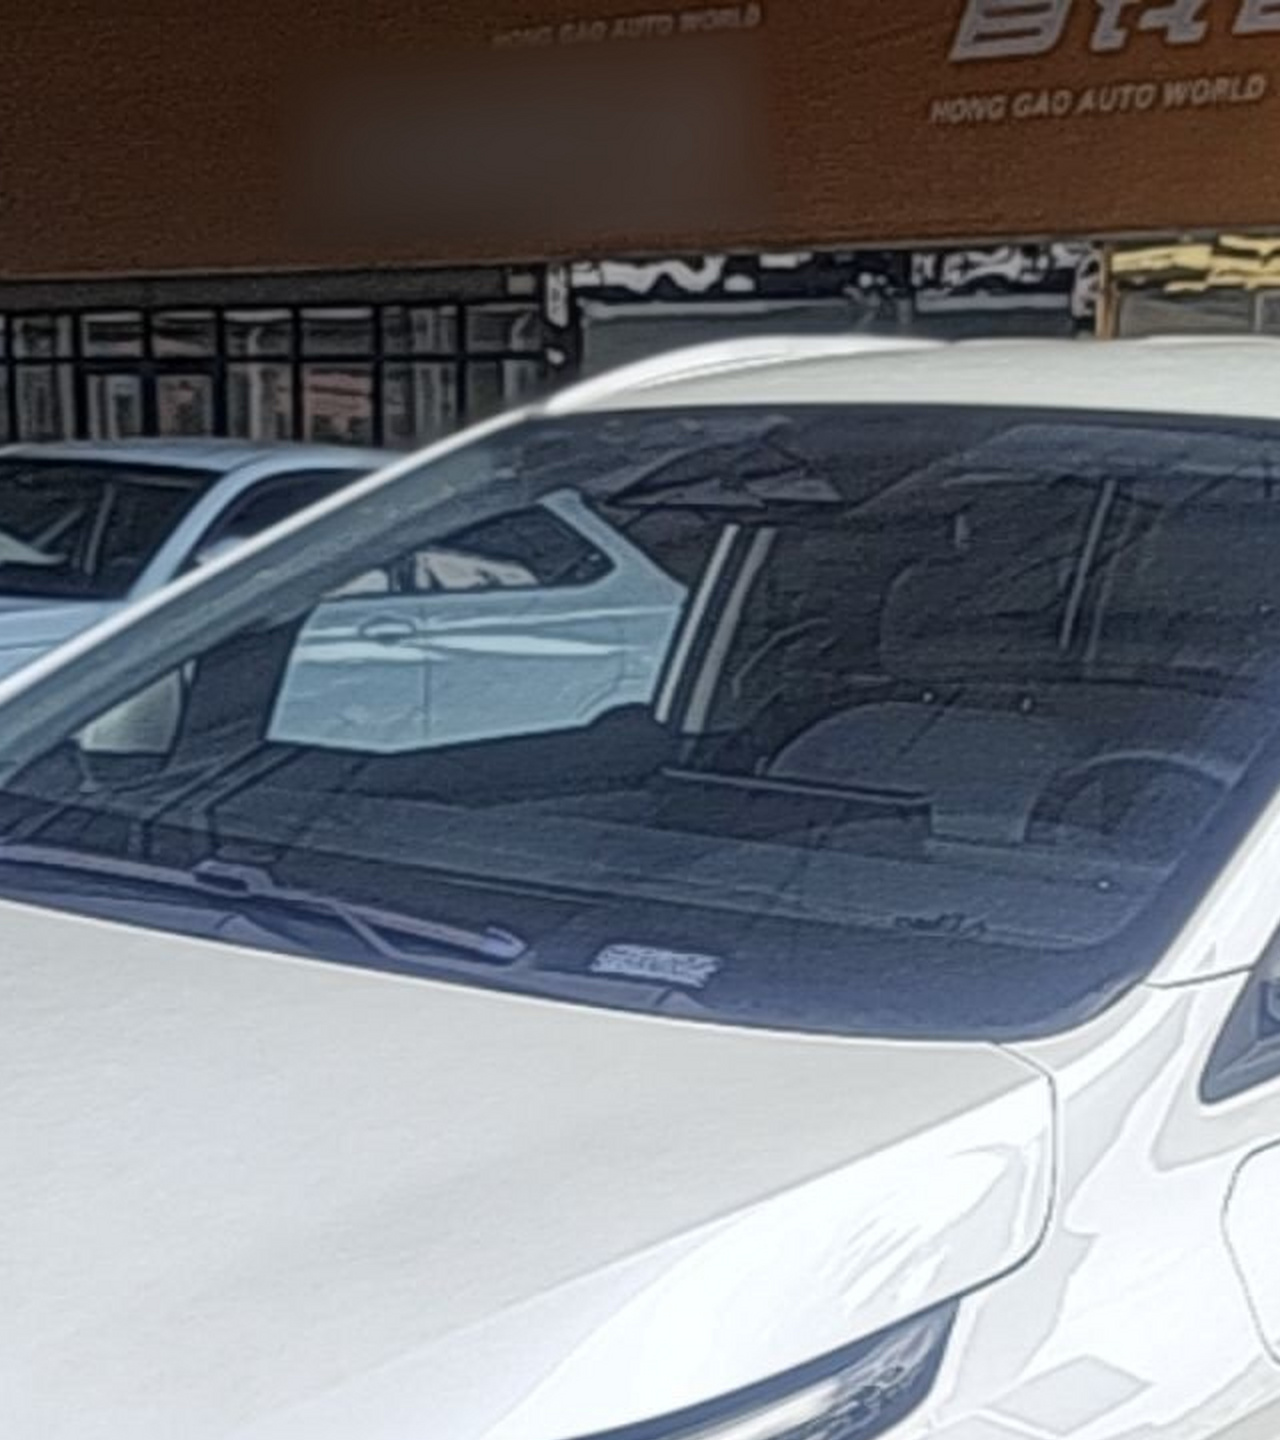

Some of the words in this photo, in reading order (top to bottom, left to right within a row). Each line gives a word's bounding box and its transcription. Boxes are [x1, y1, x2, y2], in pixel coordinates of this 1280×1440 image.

[929, 94, 1008, 124] HONG
[1012, 89, 1073, 118] GAO
[1073, 83, 1157, 113] AUTO
[1163, 73, 1267, 106] WORLD
